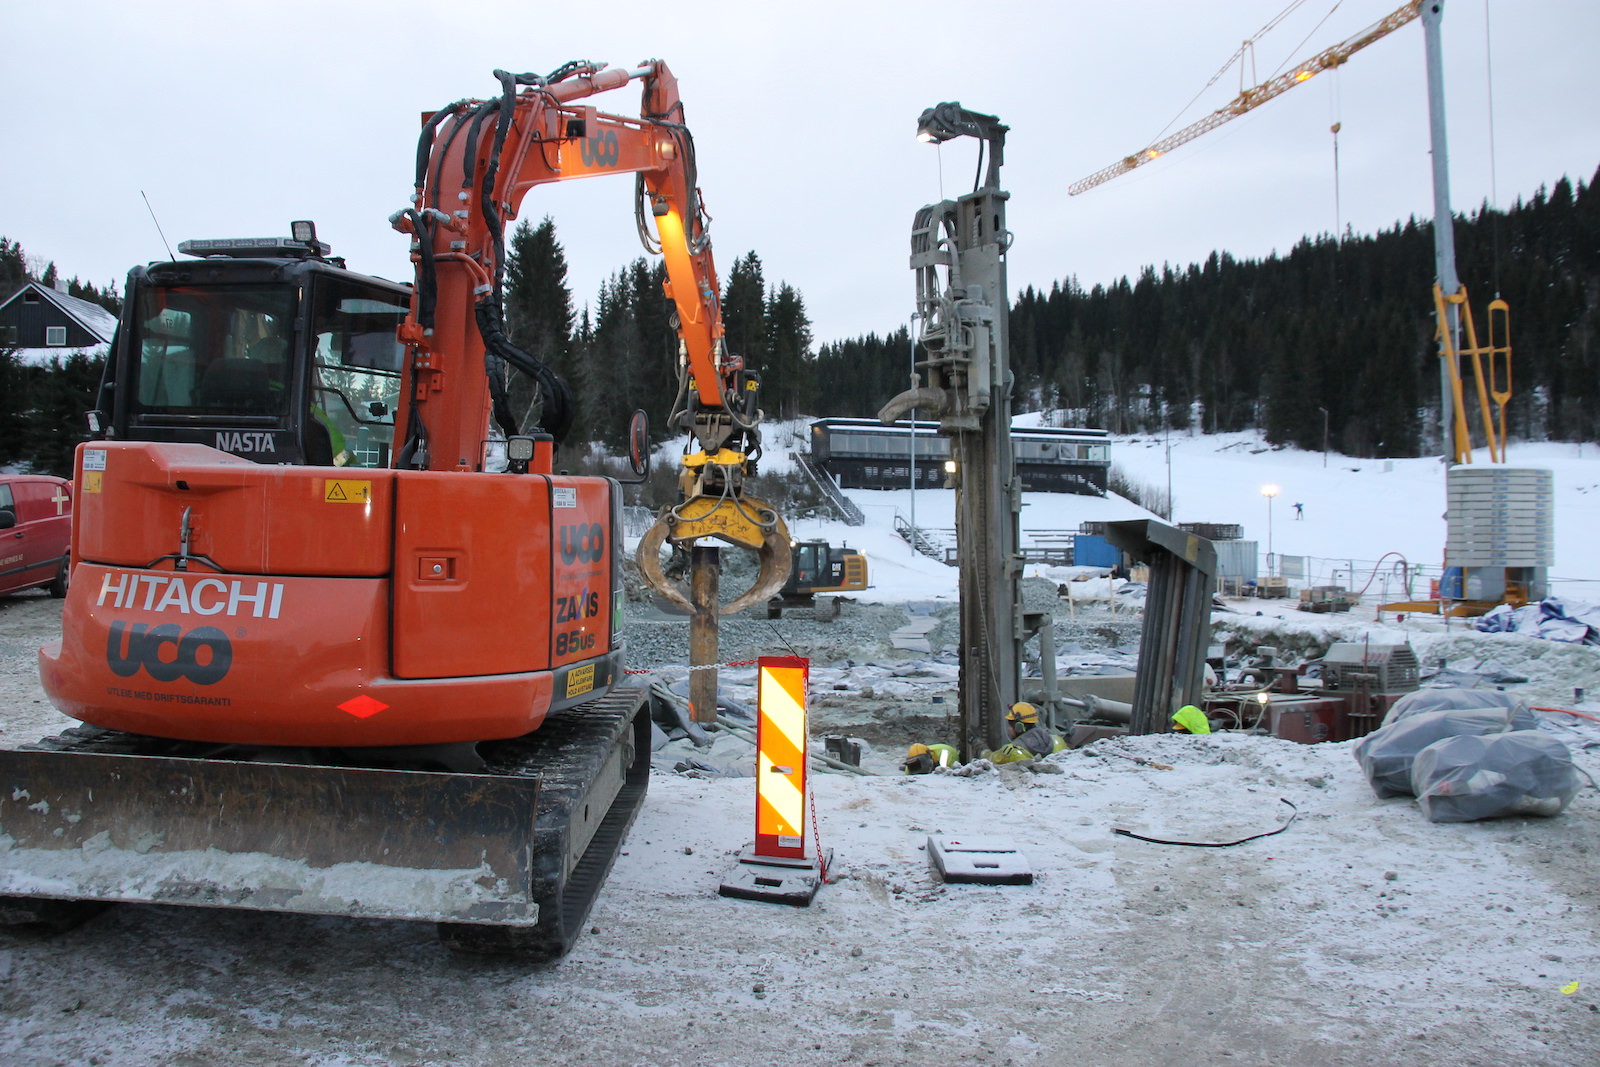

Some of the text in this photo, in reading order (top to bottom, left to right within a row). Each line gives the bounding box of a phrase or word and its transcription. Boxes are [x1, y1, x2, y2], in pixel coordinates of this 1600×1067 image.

[215, 431, 276, 452] NASTA
[560, 523, 604, 565] UCO
[96, 572, 284, 619] HITACHI
[556, 587, 599, 624] ZAXIS
[107, 620, 233, 685] UCO
[107, 687, 231, 706] UTLEIE MED DRIFTSGARANTI
